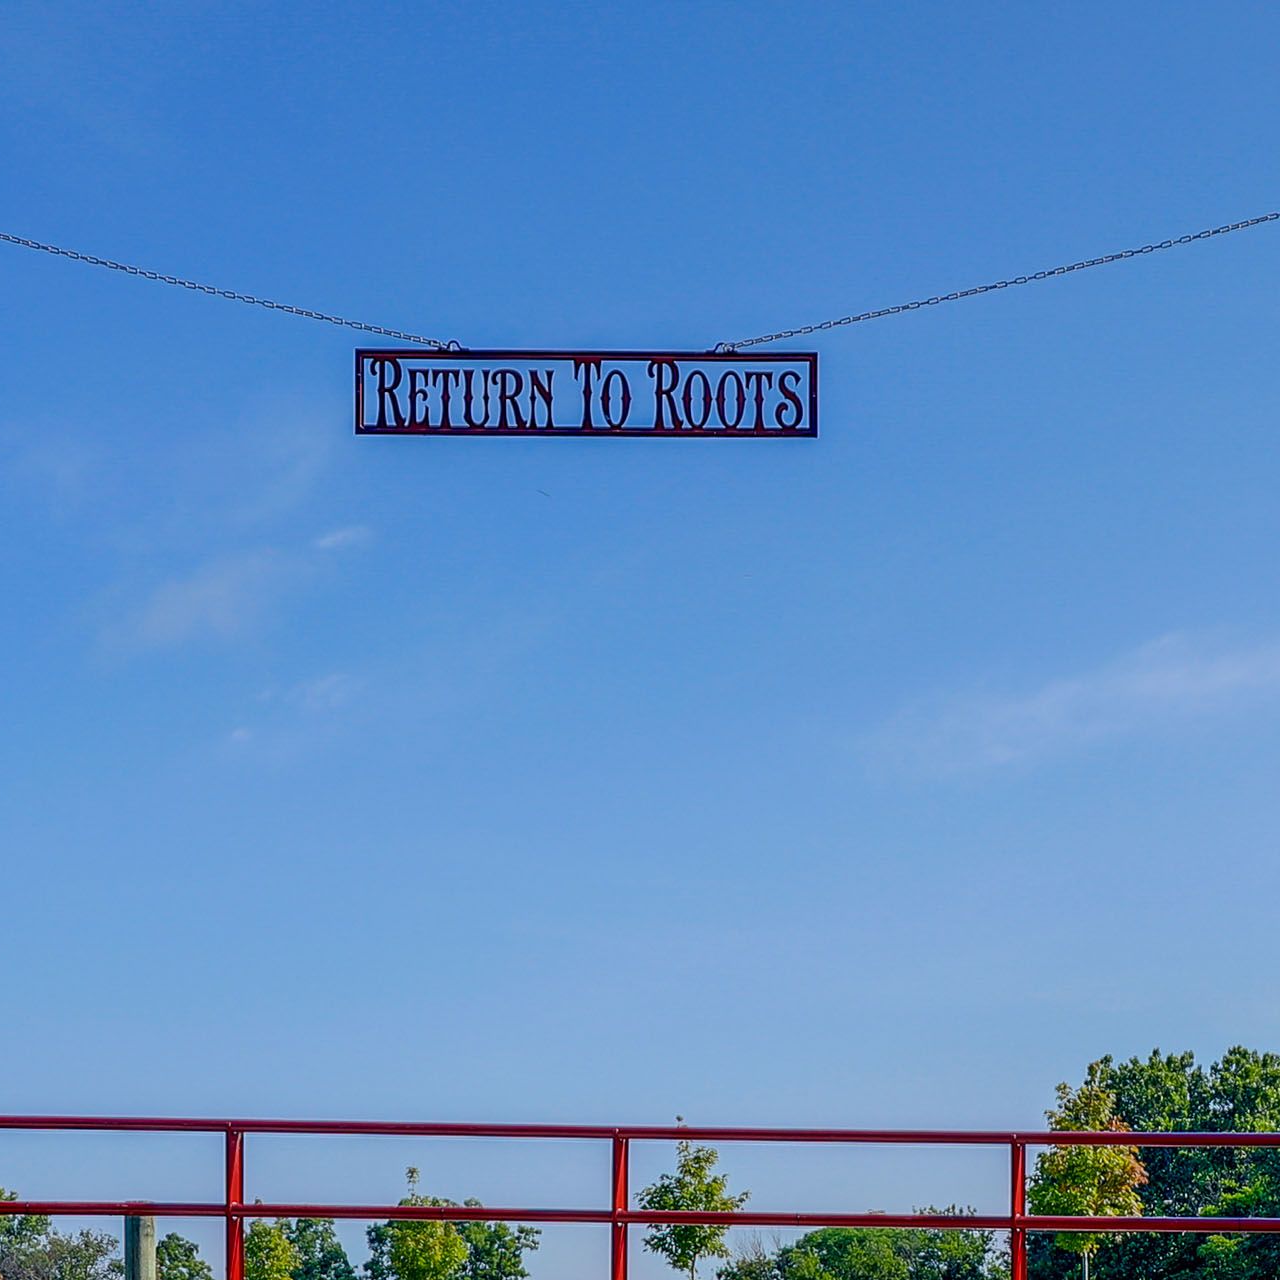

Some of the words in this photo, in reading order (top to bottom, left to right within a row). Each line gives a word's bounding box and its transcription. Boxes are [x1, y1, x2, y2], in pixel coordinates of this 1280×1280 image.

[370, 357, 555, 429] RETURN
[572, 358, 632, 430] TO
[647, 358, 804, 431] ROOTS
